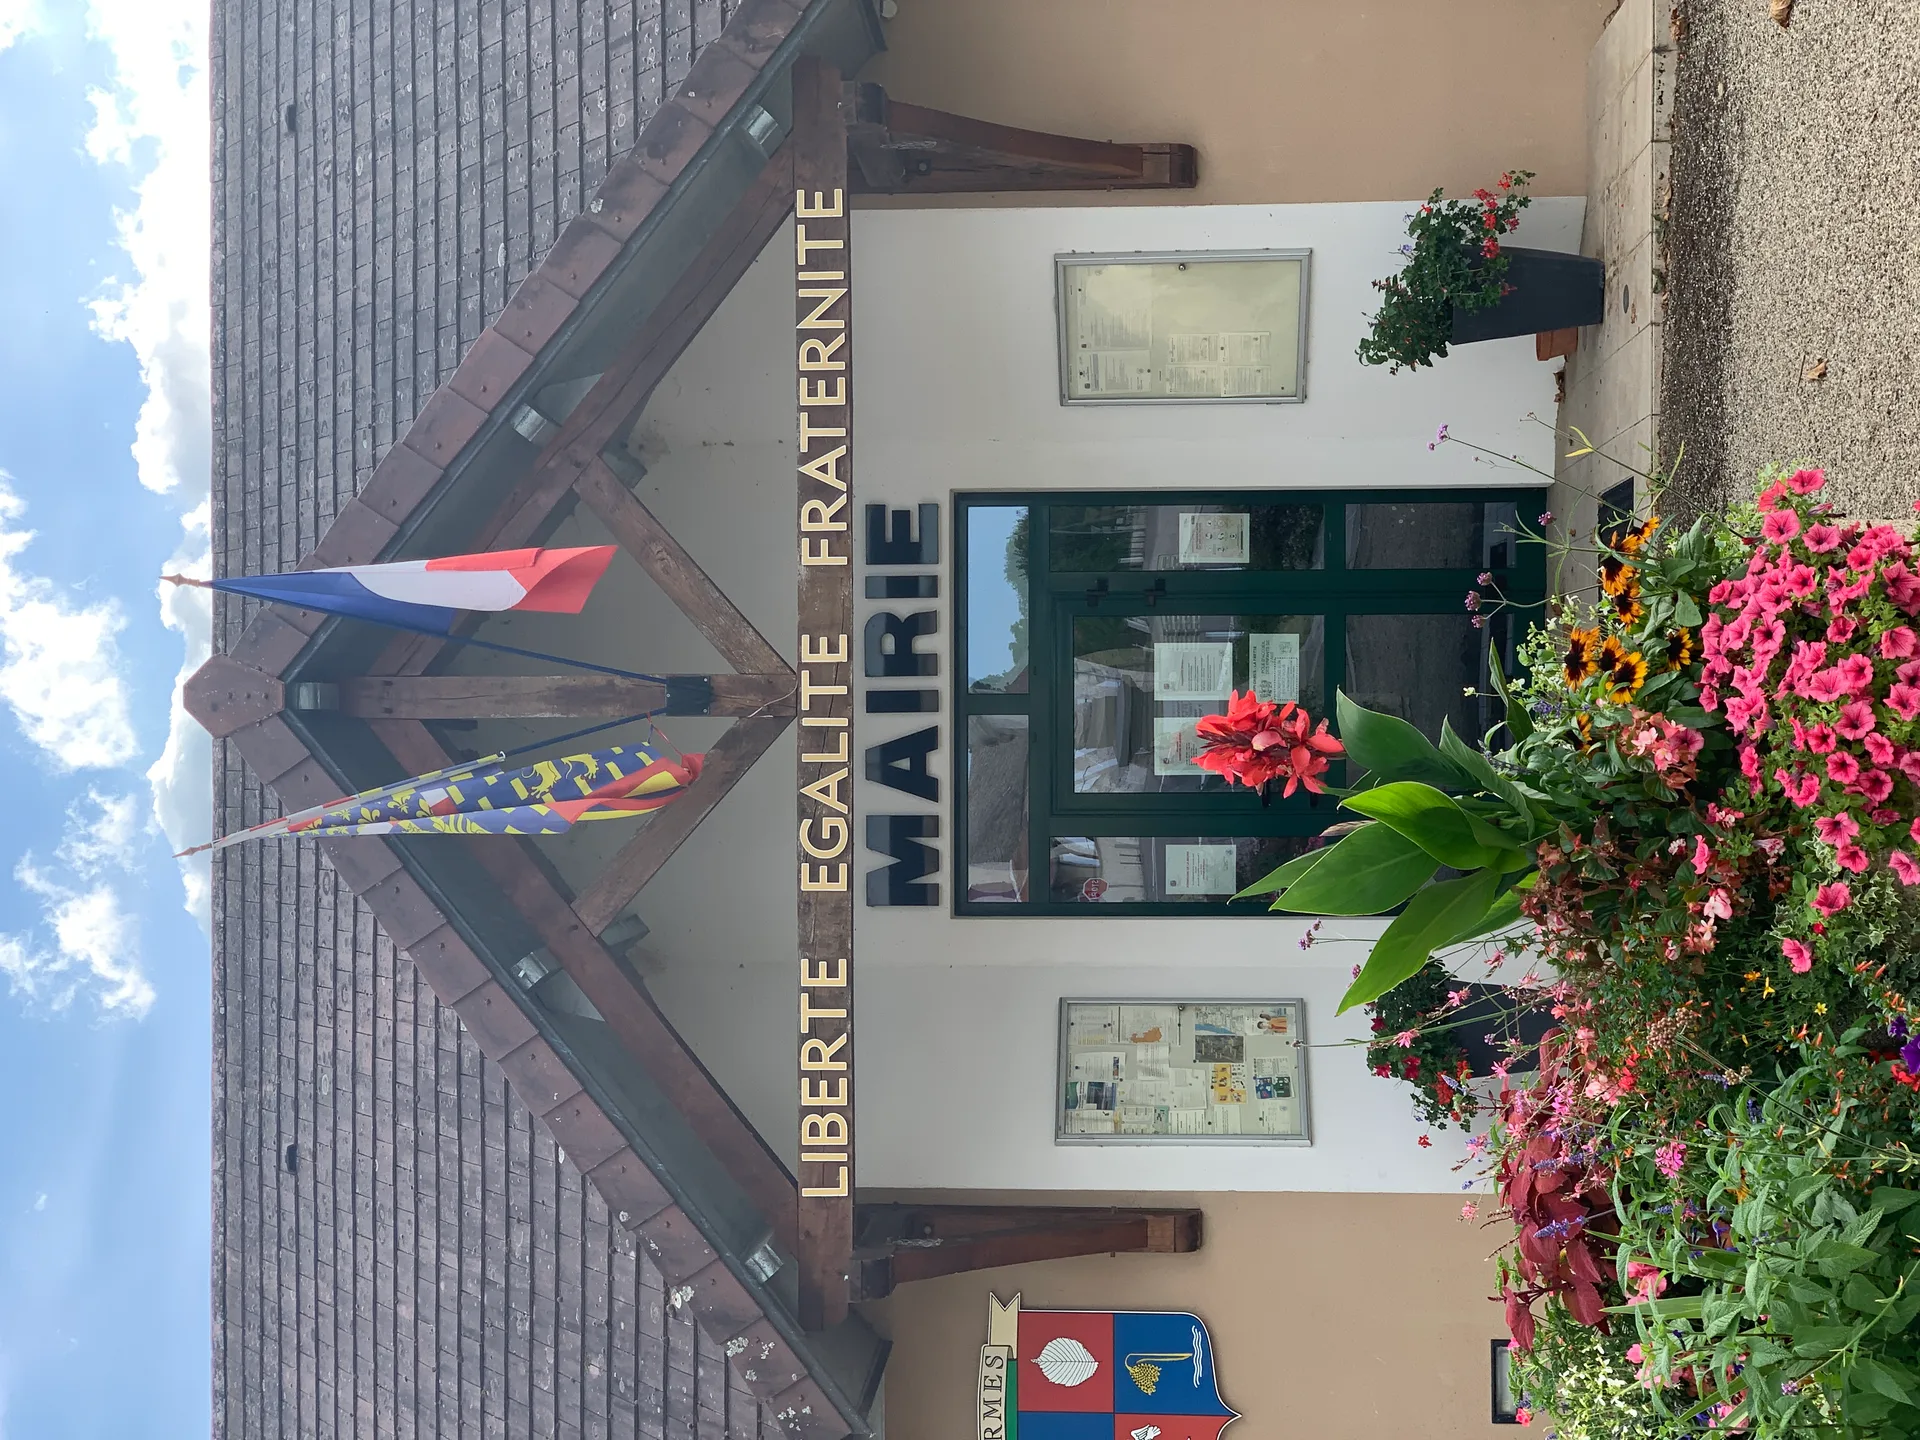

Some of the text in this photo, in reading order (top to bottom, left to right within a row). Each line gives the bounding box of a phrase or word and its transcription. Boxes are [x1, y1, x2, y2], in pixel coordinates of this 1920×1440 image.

[796, 188, 848, 1198] LIBERTE EGALITE FRATERNITE
[864, 503, 940, 908] MAIRIE
